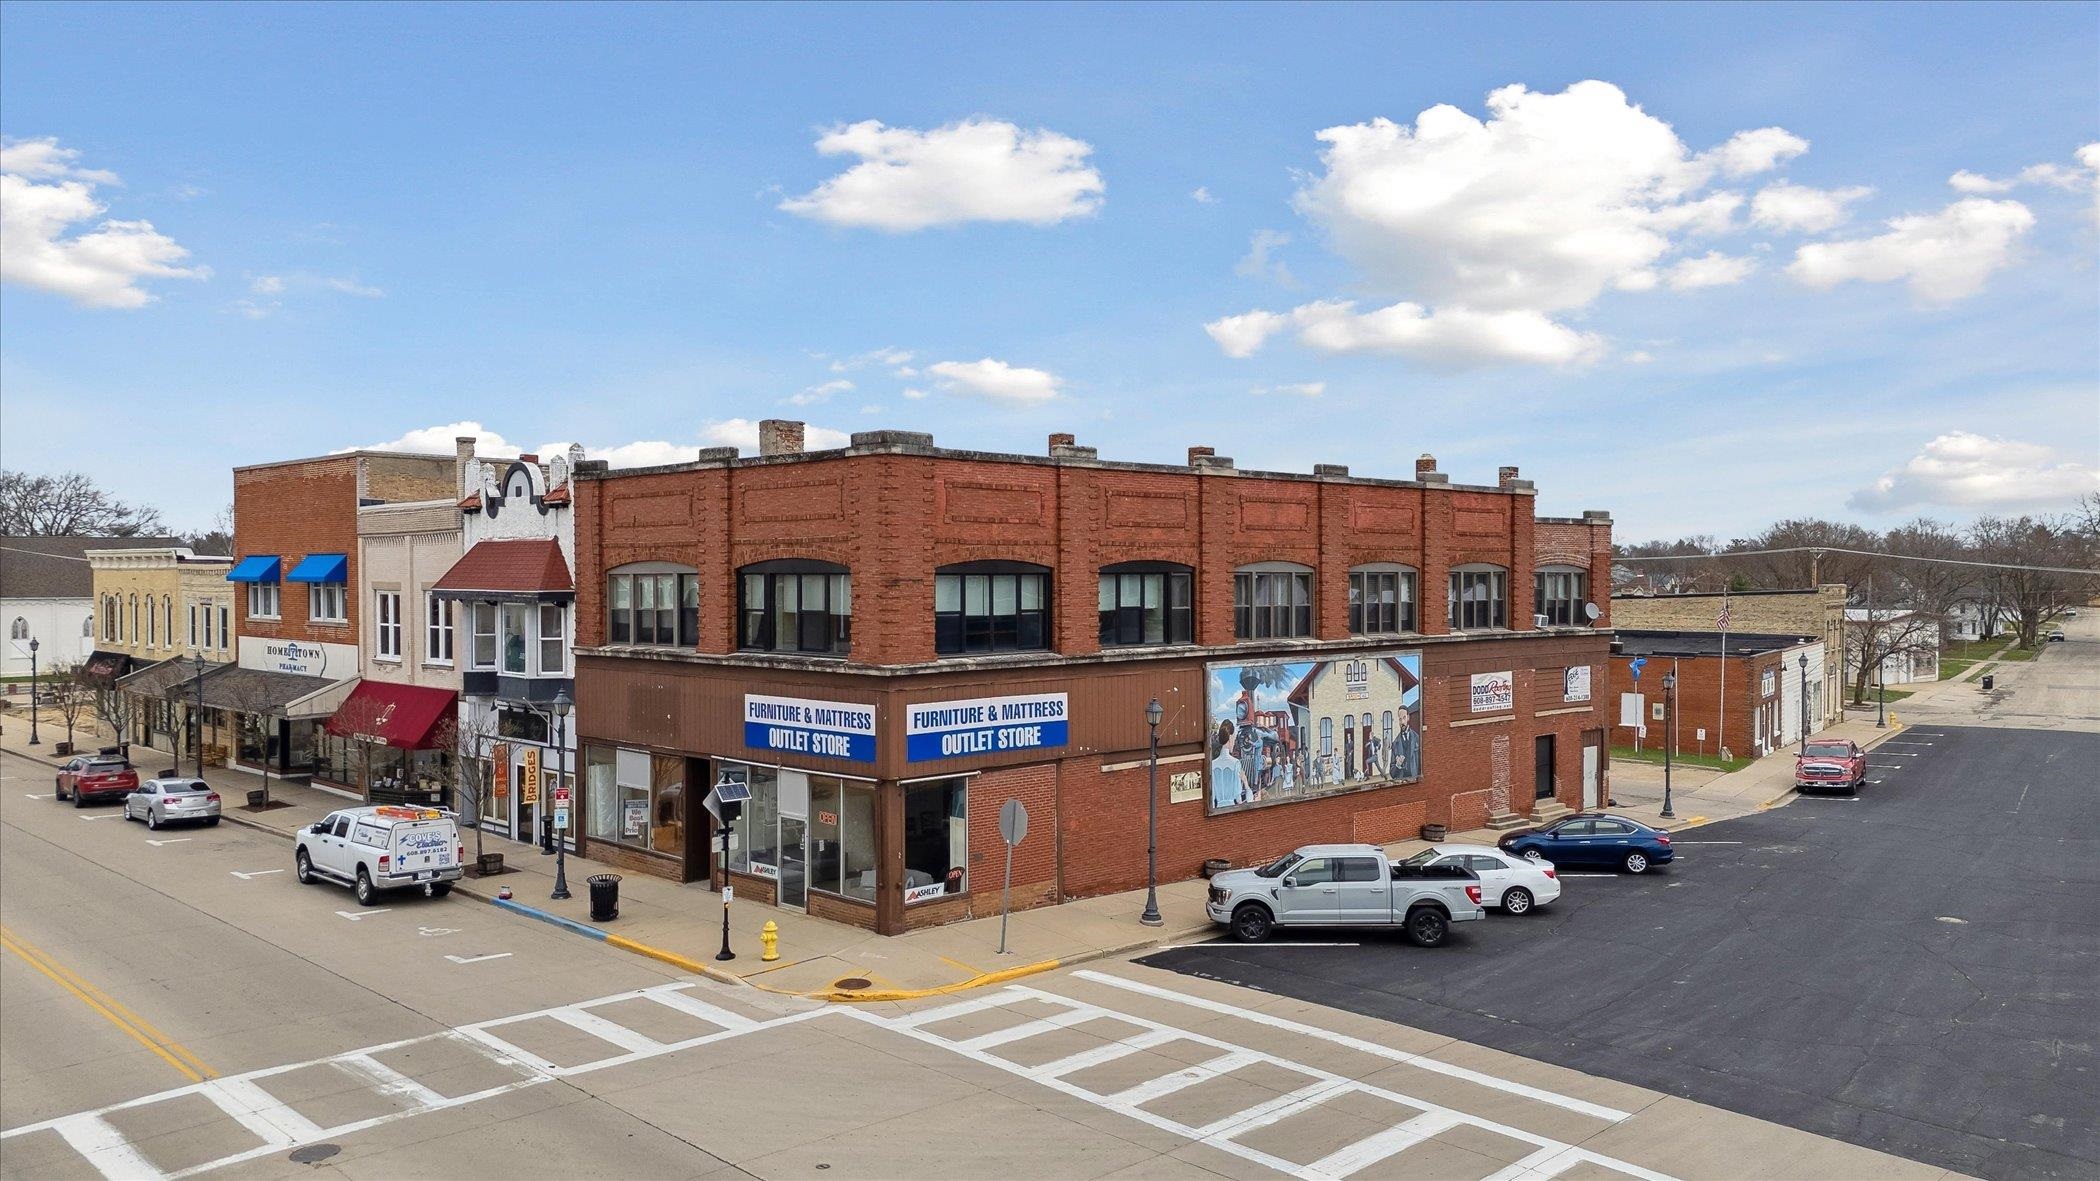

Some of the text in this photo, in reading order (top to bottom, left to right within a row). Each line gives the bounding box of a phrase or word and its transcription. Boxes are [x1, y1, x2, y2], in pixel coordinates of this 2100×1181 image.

[279, 662, 307, 672] PHARMACY
[1473, 685, 1489, 695] DODD
[749, 702, 871, 730] FURNITURE & MATTRESS
[913, 700, 1063, 729] FURNITURE & MATTRESS
[769, 727, 850, 757] OUTLET STORE
[942, 725, 1041, 756] OUTLET STORE
[526, 750, 537, 801] BRIDGES
[819, 812, 837, 825] OPEN
[948, 870, 962, 880] OPEN
[916, 887, 941, 898] ASHLEY
